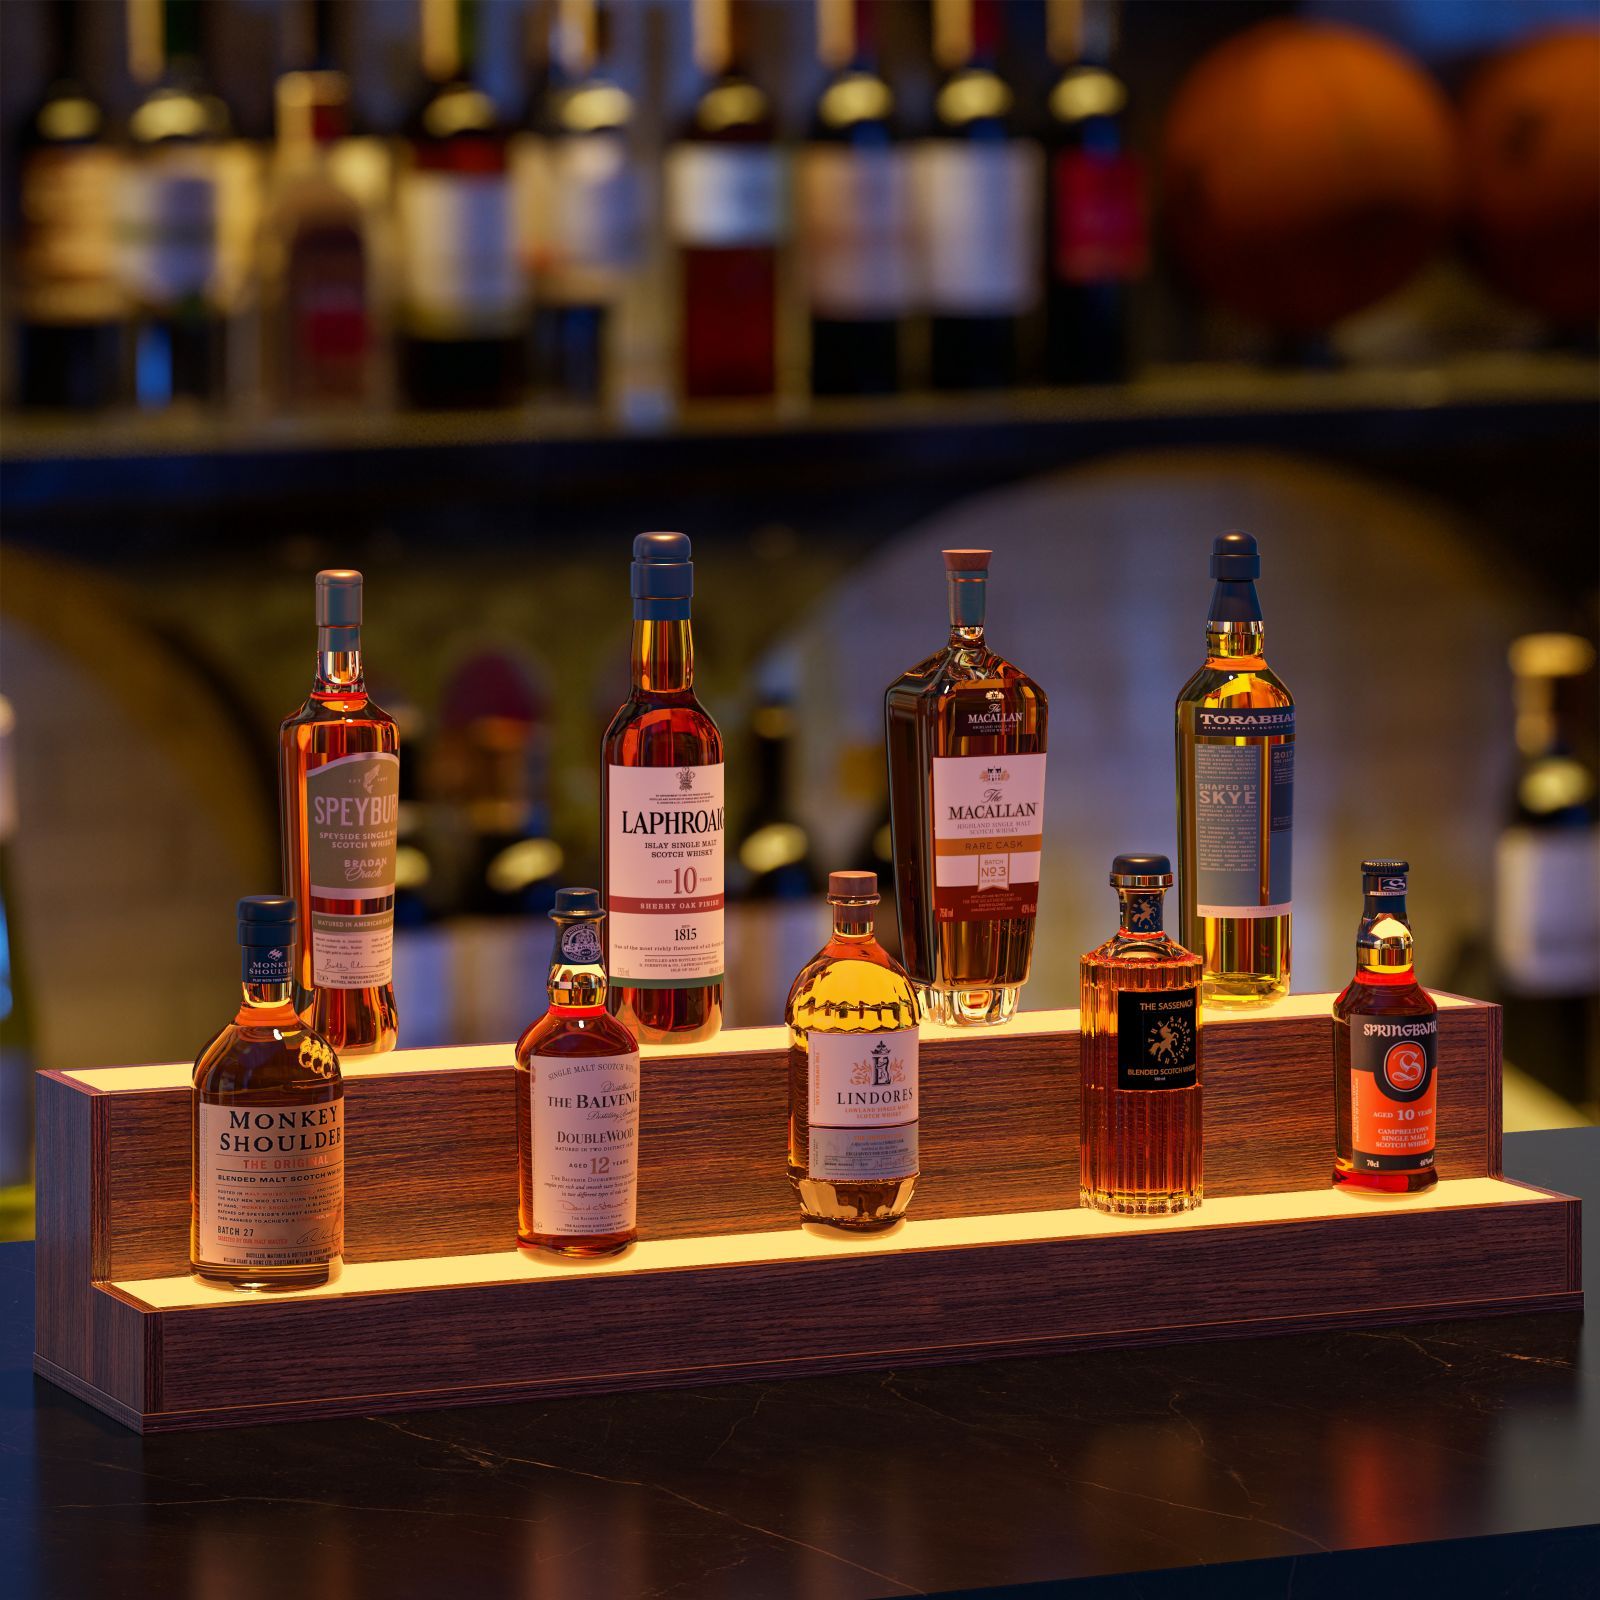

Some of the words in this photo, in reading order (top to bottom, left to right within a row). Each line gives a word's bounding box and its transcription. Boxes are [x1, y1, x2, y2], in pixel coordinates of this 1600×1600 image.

[968, 712, 1024, 724] MACALLAN
[1199, 791, 1257, 804] SKYE
[948, 802, 1039, 820] MACALLAN
[319, 831, 361, 840] SPEYSIDE
[331, 841, 368, 849] SCOTCH
[671, 841, 701, 849] SINGLE
[701, 839, 717, 847] MALT
[965, 841, 992, 850] RARE
[995, 840, 1024, 849] CASK
[686, 849, 713, 857] WHISKY
[344, 857, 388, 868] BRADAN
[673, 866, 698, 895] 10
[674, 928, 697, 941] 1815
[1139, 1003, 1157, 1011] THE
[547, 1067, 572, 1080] SINGLE
[574, 1063, 595, 1074] MALT
[598, 1063, 624, 1071] SCOTCH
[1127, 1068, 1159, 1076] BLENDED
[1160, 1067, 1182, 1075] SCOTCH
[548, 1096, 573, 1109] THE
[576, 1089, 638, 1109] BALVENIE
[837, 1087, 913, 1105] LINDORES
[229, 1105, 337, 1129] MONKEY
[1397, 1108, 1415, 1121] 10
[243, 1160, 267, 1169] THE
[590, 1156, 610, 1175] 12
[218, 1174, 256, 1183] BLENDED
[290, 1172, 326, 1182] SCOTCH
[217, 1226, 240, 1236] BATCH
[243, 1228, 254, 1237] 27
